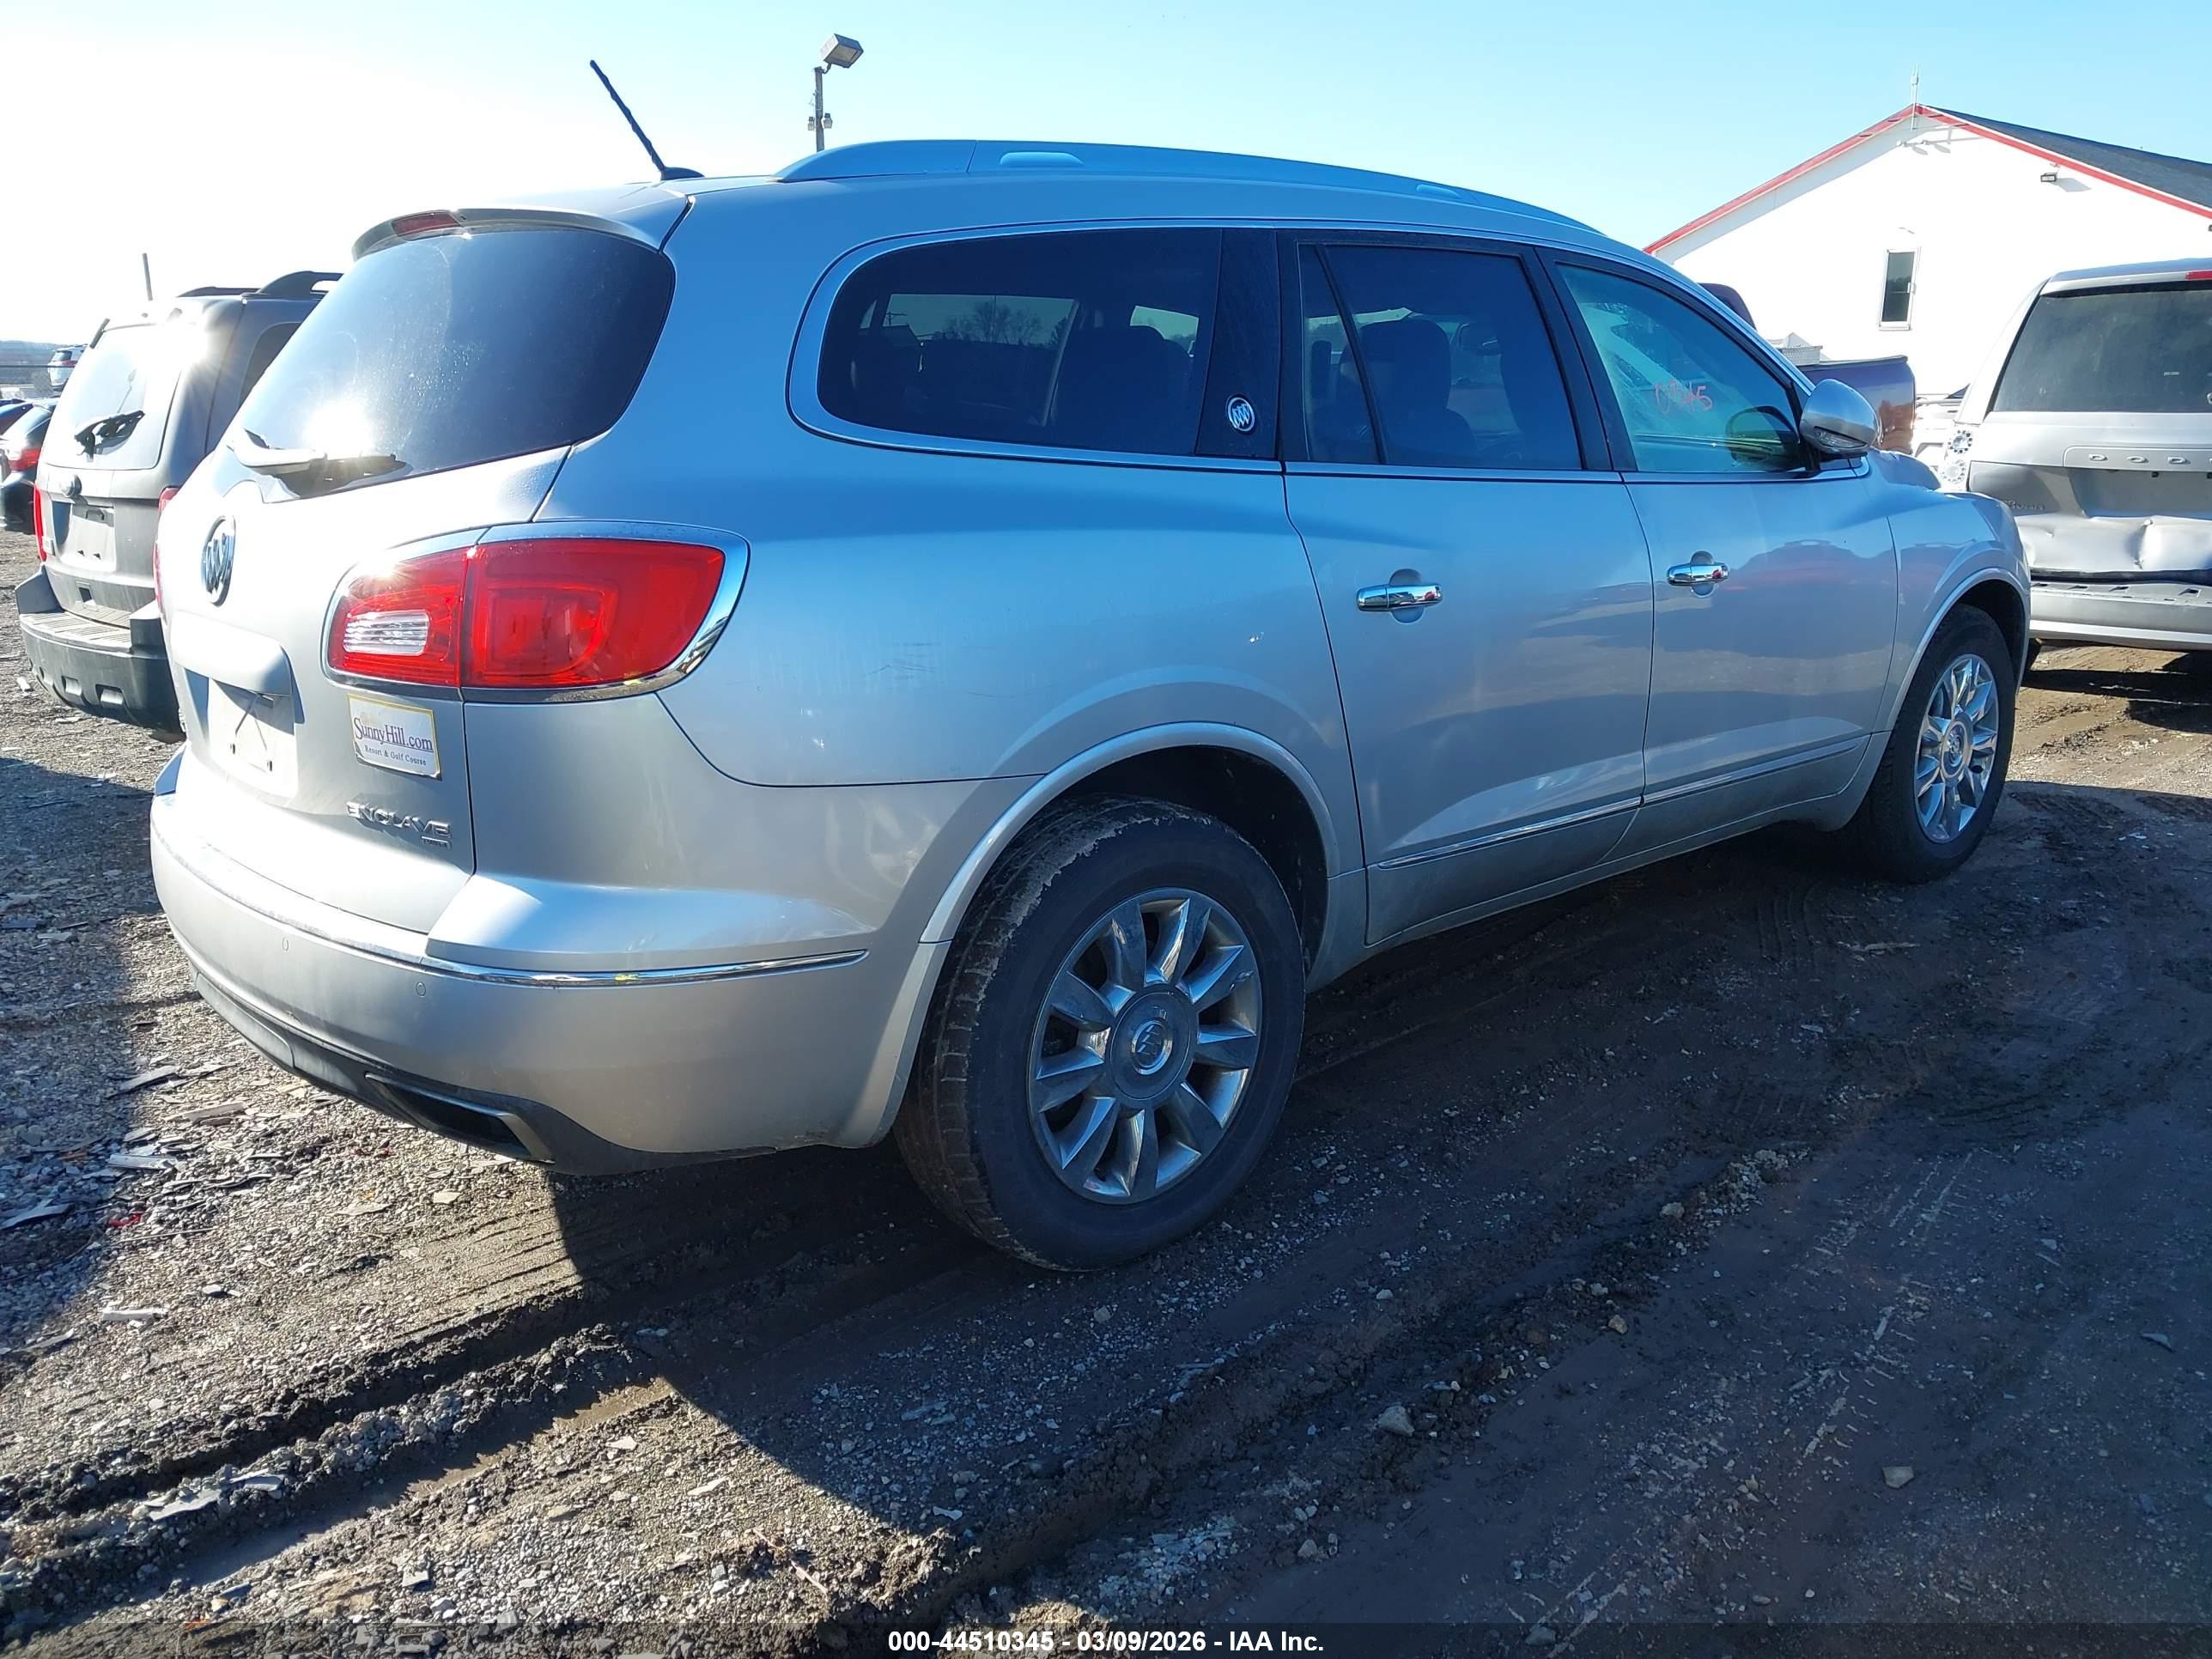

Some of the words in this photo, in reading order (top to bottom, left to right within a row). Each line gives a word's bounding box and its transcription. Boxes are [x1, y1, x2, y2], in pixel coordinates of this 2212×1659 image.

[2088, 453, 2212, 465] DOD
[354, 717, 434, 750] SunnyHill.com
[364, 744, 382, 757] Resort
[390, 751, 404, 762] Golf
[404, 754, 427, 766] Course
[346, 801, 453, 838] ENCLAVE
